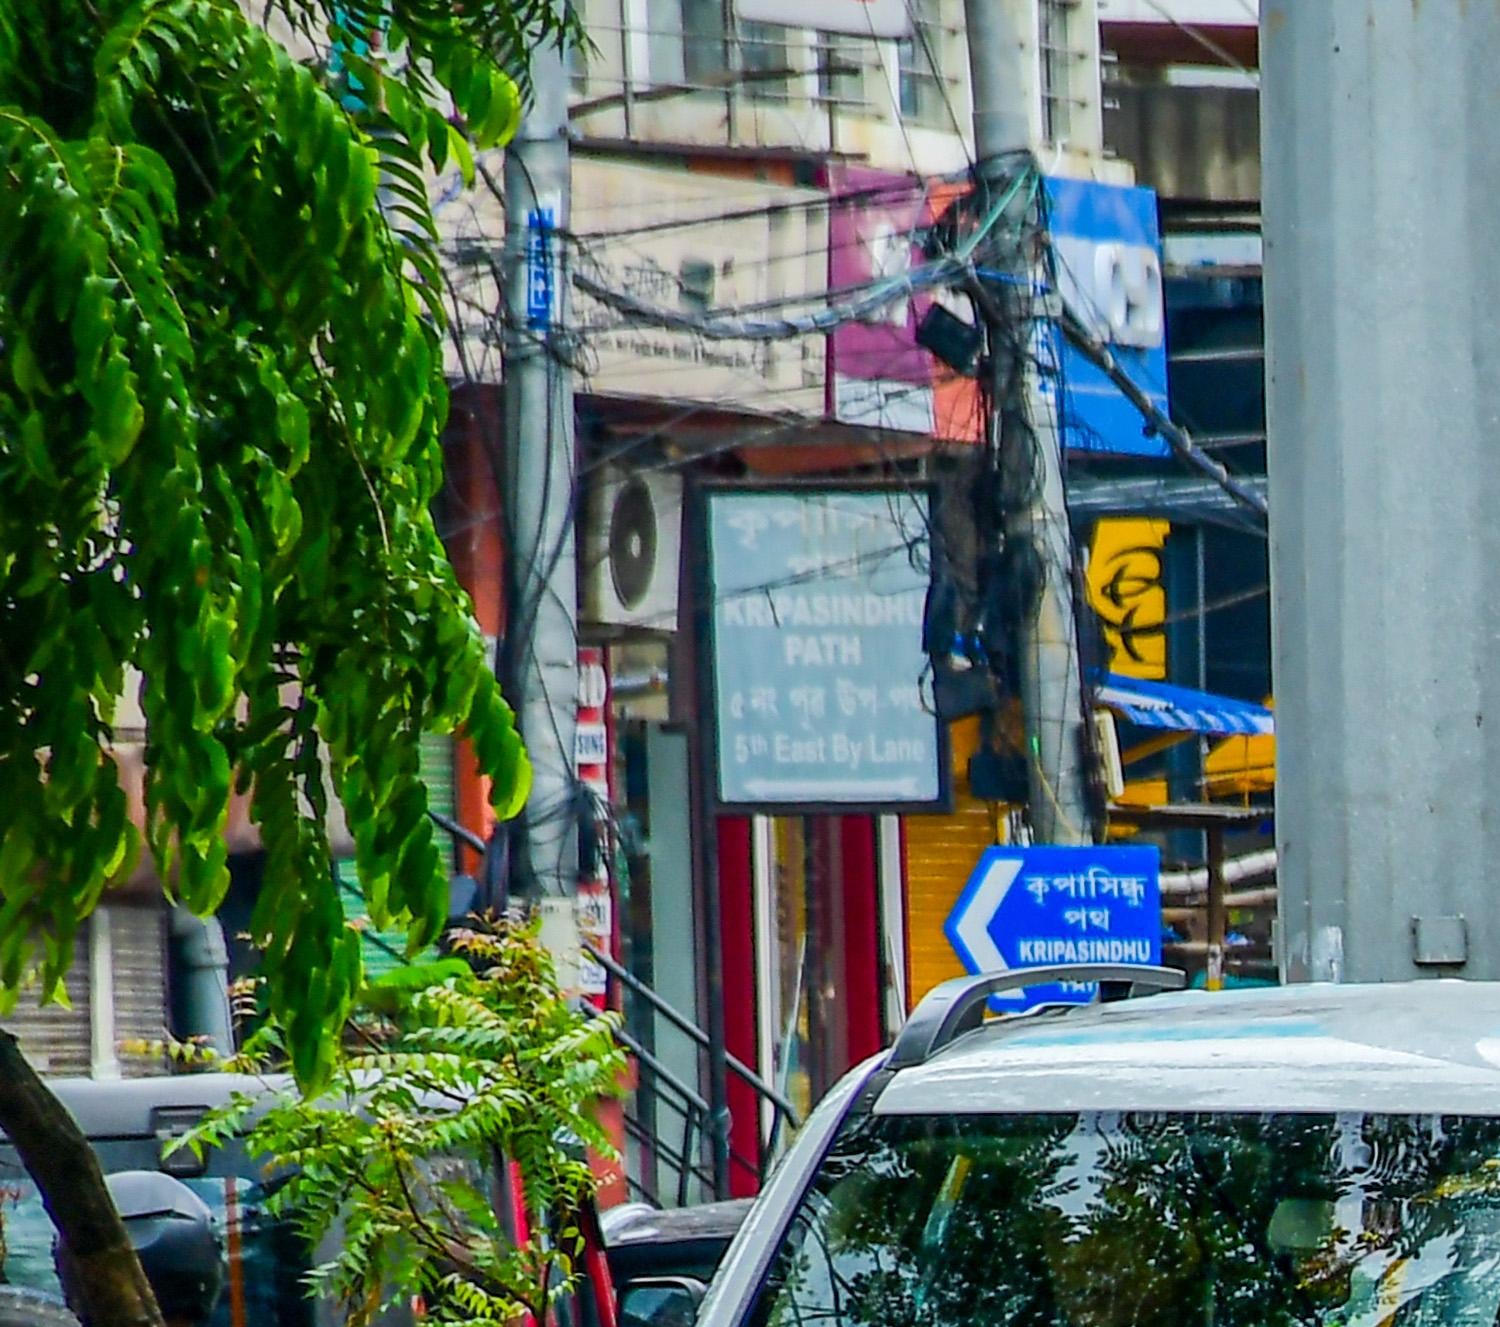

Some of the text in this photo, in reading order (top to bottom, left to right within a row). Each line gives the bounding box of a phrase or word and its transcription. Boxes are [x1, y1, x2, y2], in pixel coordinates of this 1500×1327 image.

[785, 635, 862, 665] PATH
[735, 733, 924, 769] 5th East By Lane
[1019, 939, 1150, 963] KRIPASINDHU
